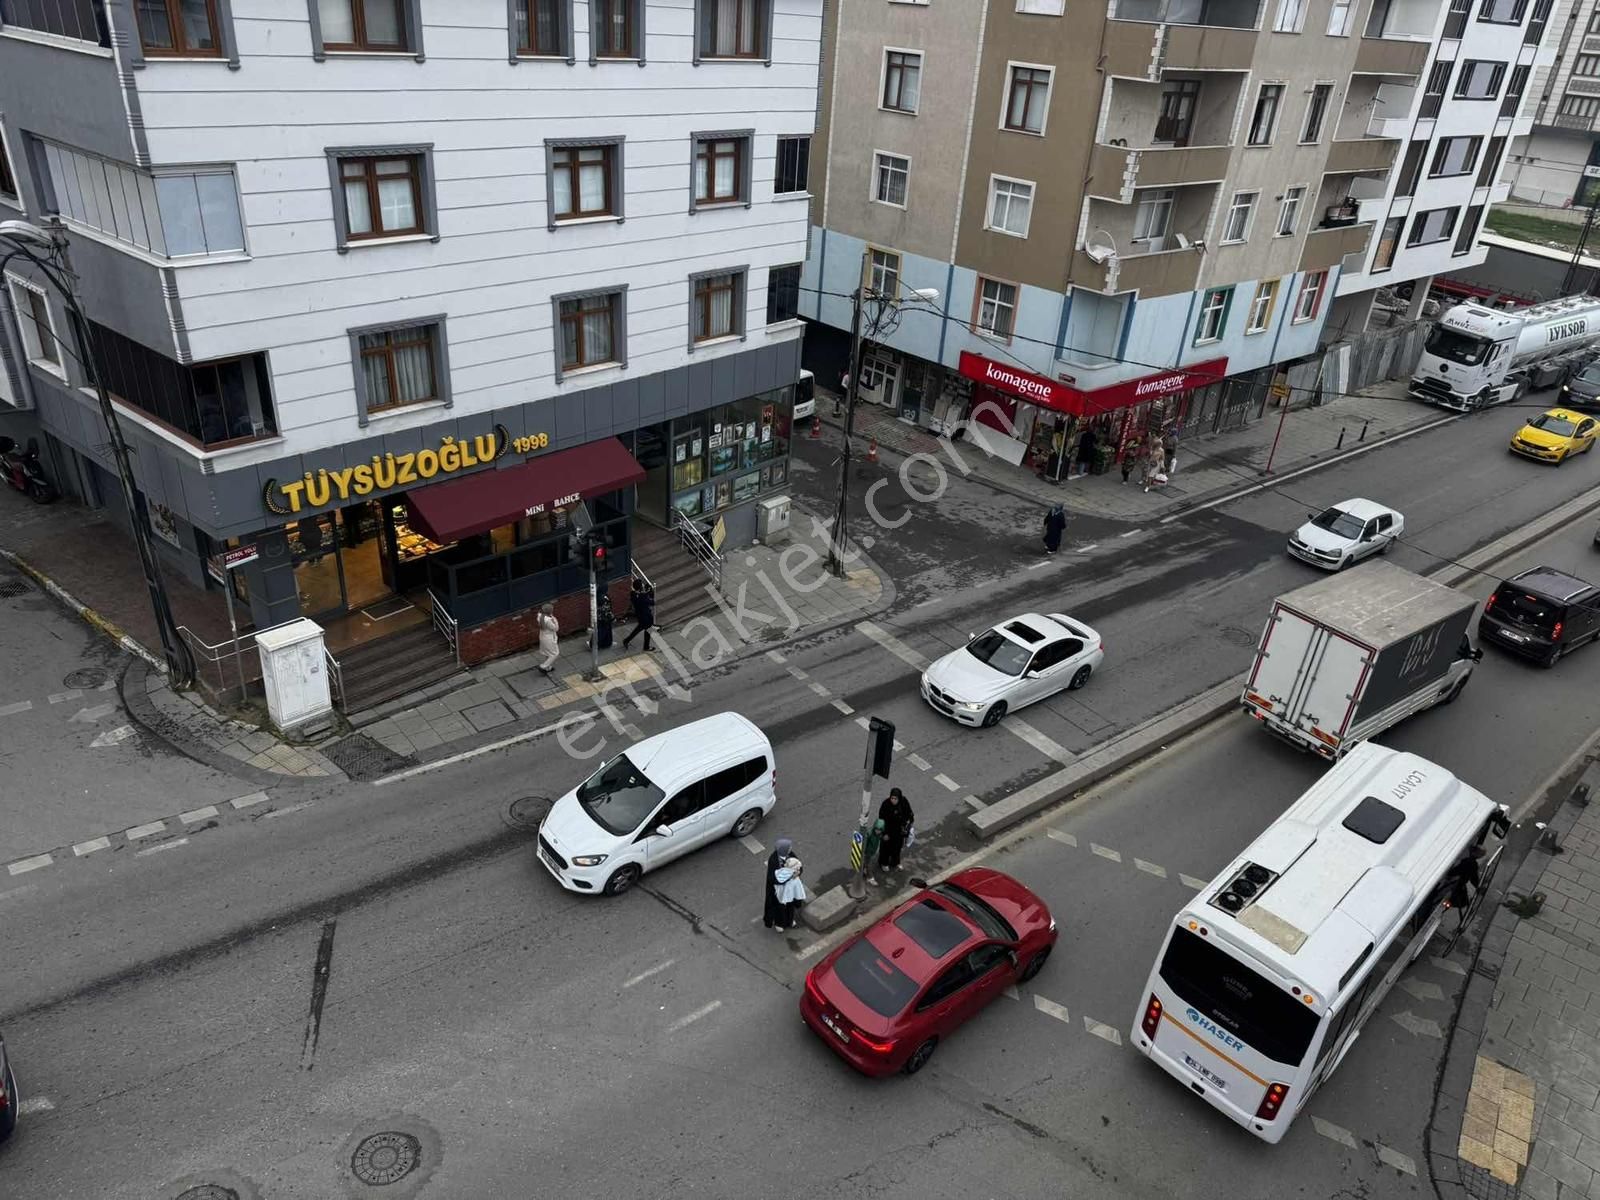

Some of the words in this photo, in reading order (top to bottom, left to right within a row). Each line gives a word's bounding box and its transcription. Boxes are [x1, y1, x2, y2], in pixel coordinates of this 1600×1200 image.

[1549, 319, 1586, 342] LYKSOR
[986, 362, 1052, 398] komagene
[1135, 373, 1186, 396] komagene
[281, 434, 496, 513] TÜYSÜZOĞLU
[513, 432, 548, 454] 1998
[1198, 1017, 1245, 1052] HASER
